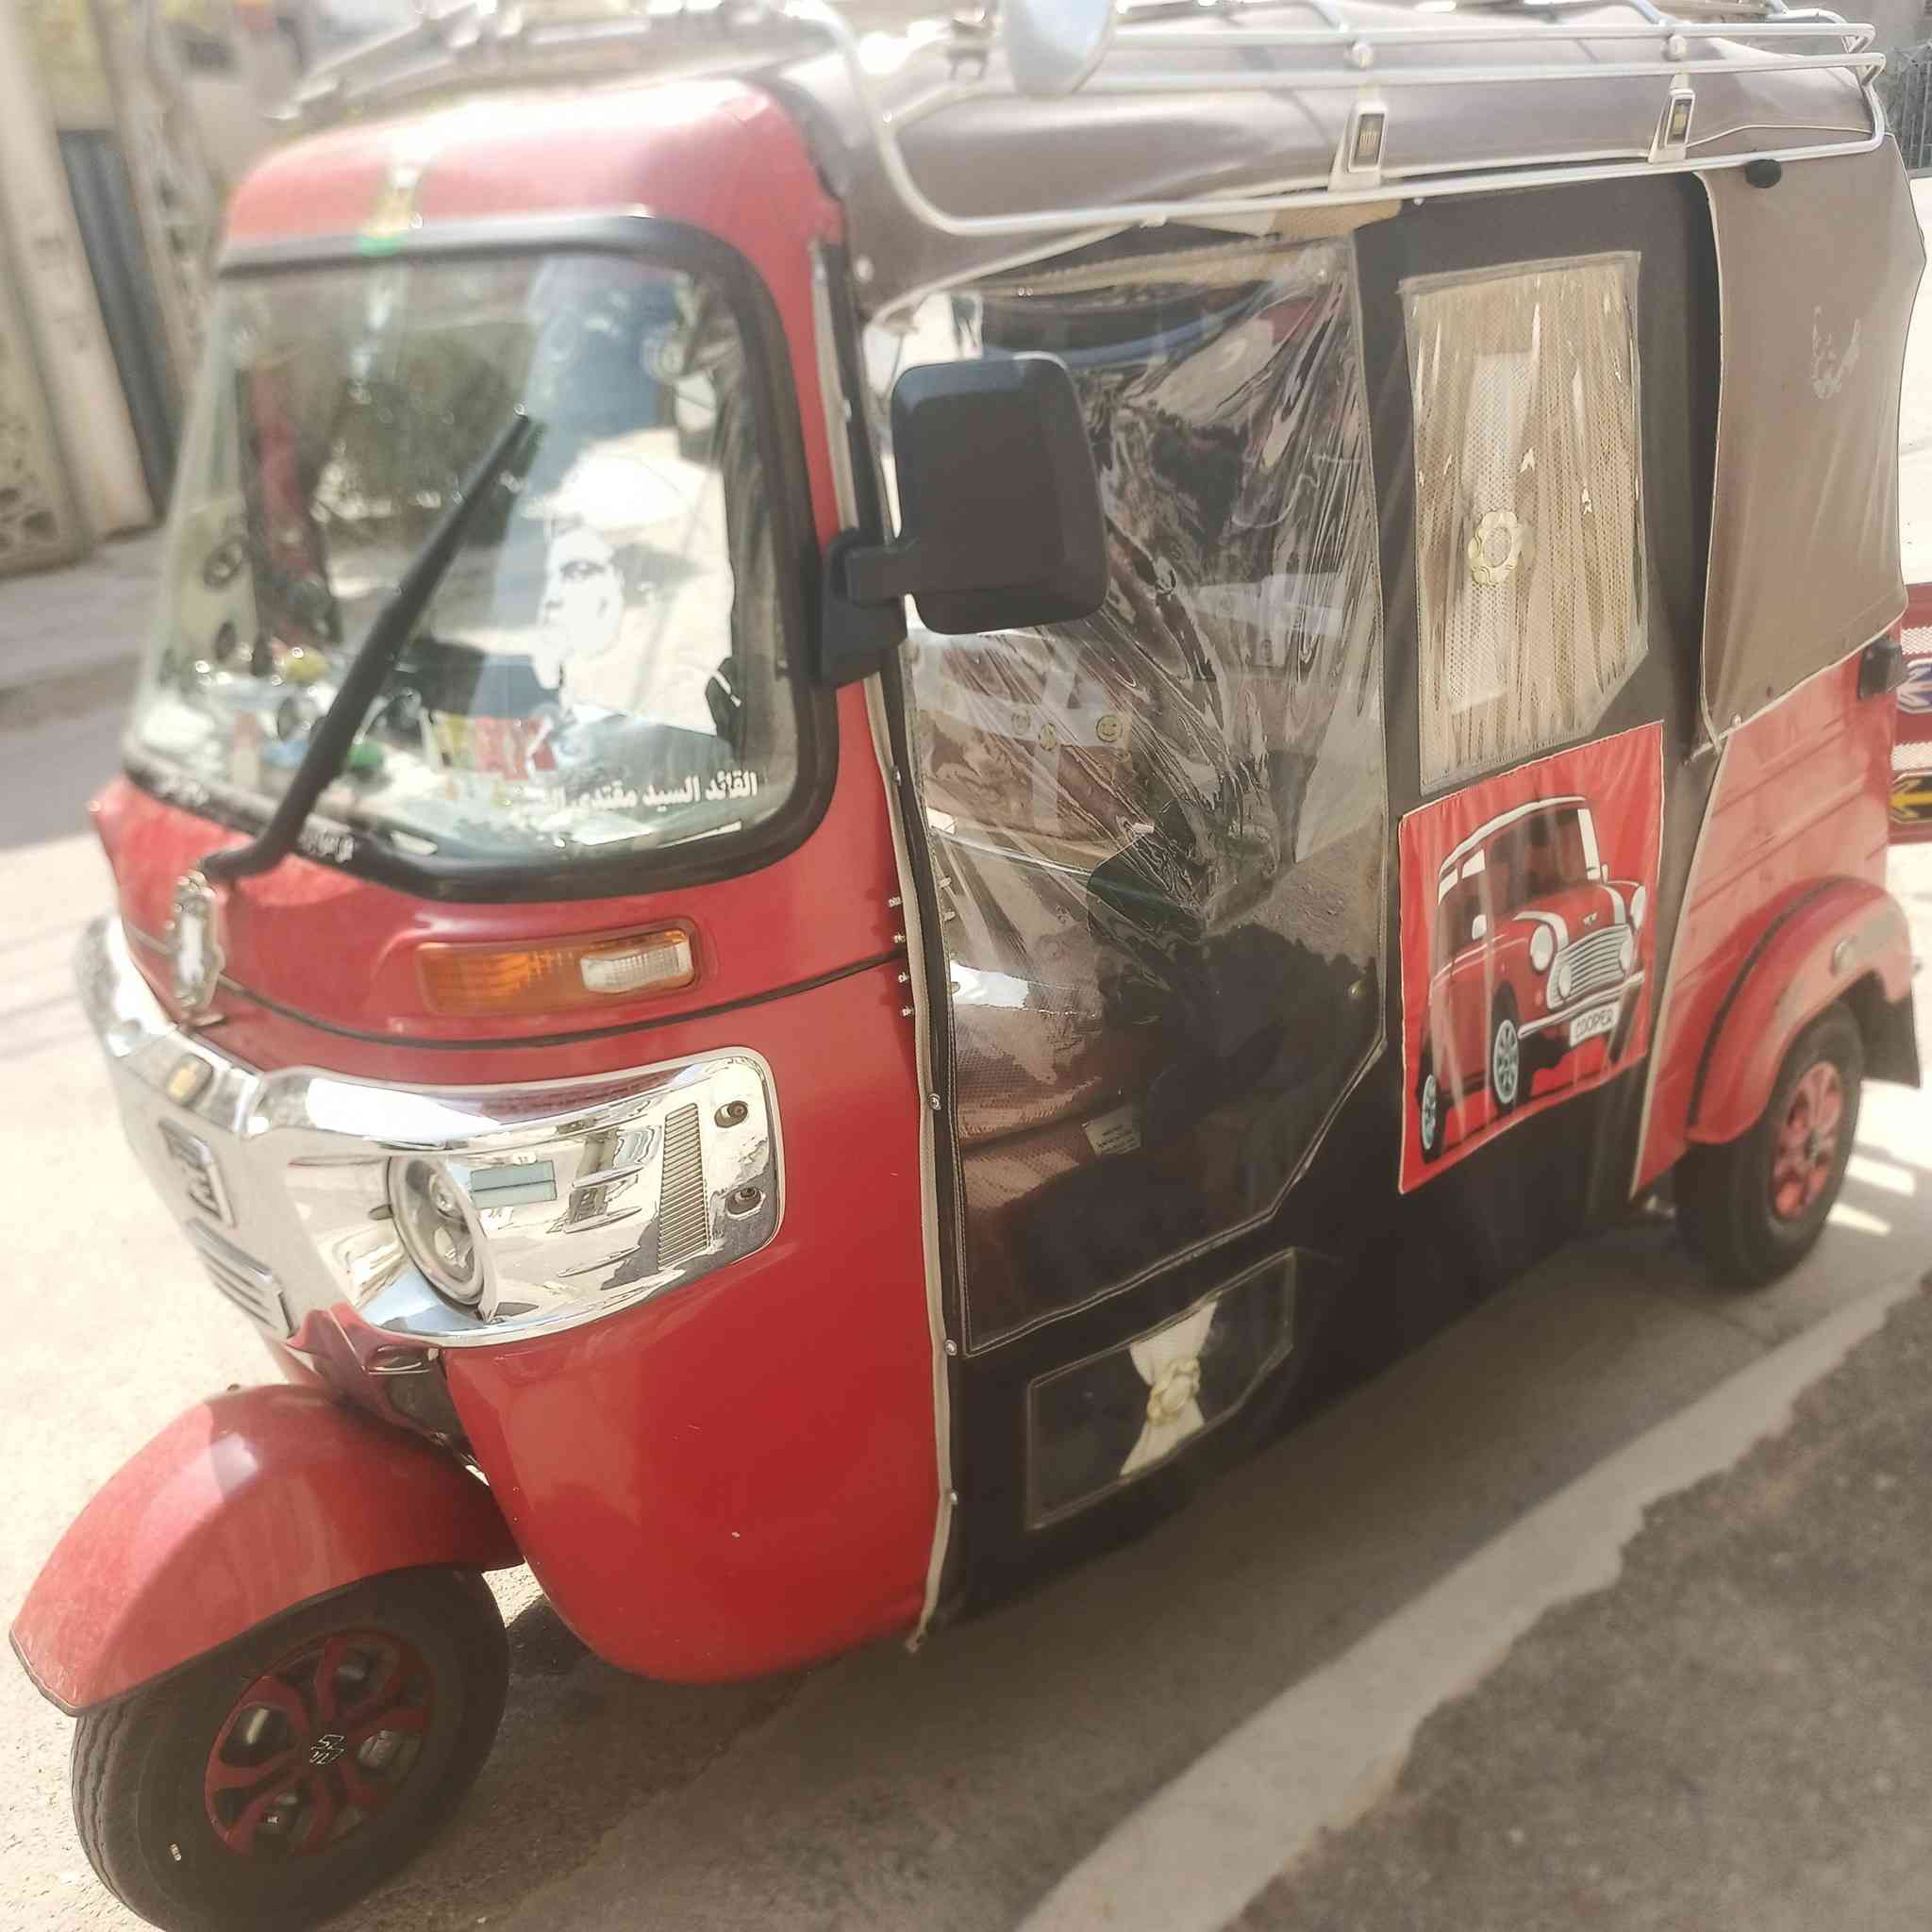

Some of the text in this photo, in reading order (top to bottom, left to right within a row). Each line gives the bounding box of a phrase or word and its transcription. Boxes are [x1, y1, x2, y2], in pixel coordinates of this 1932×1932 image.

[641, 774, 701, 812] السيد
[705, 769, 758, 801] القائد
[1575, 1008, 1614, 1038] COOPER
